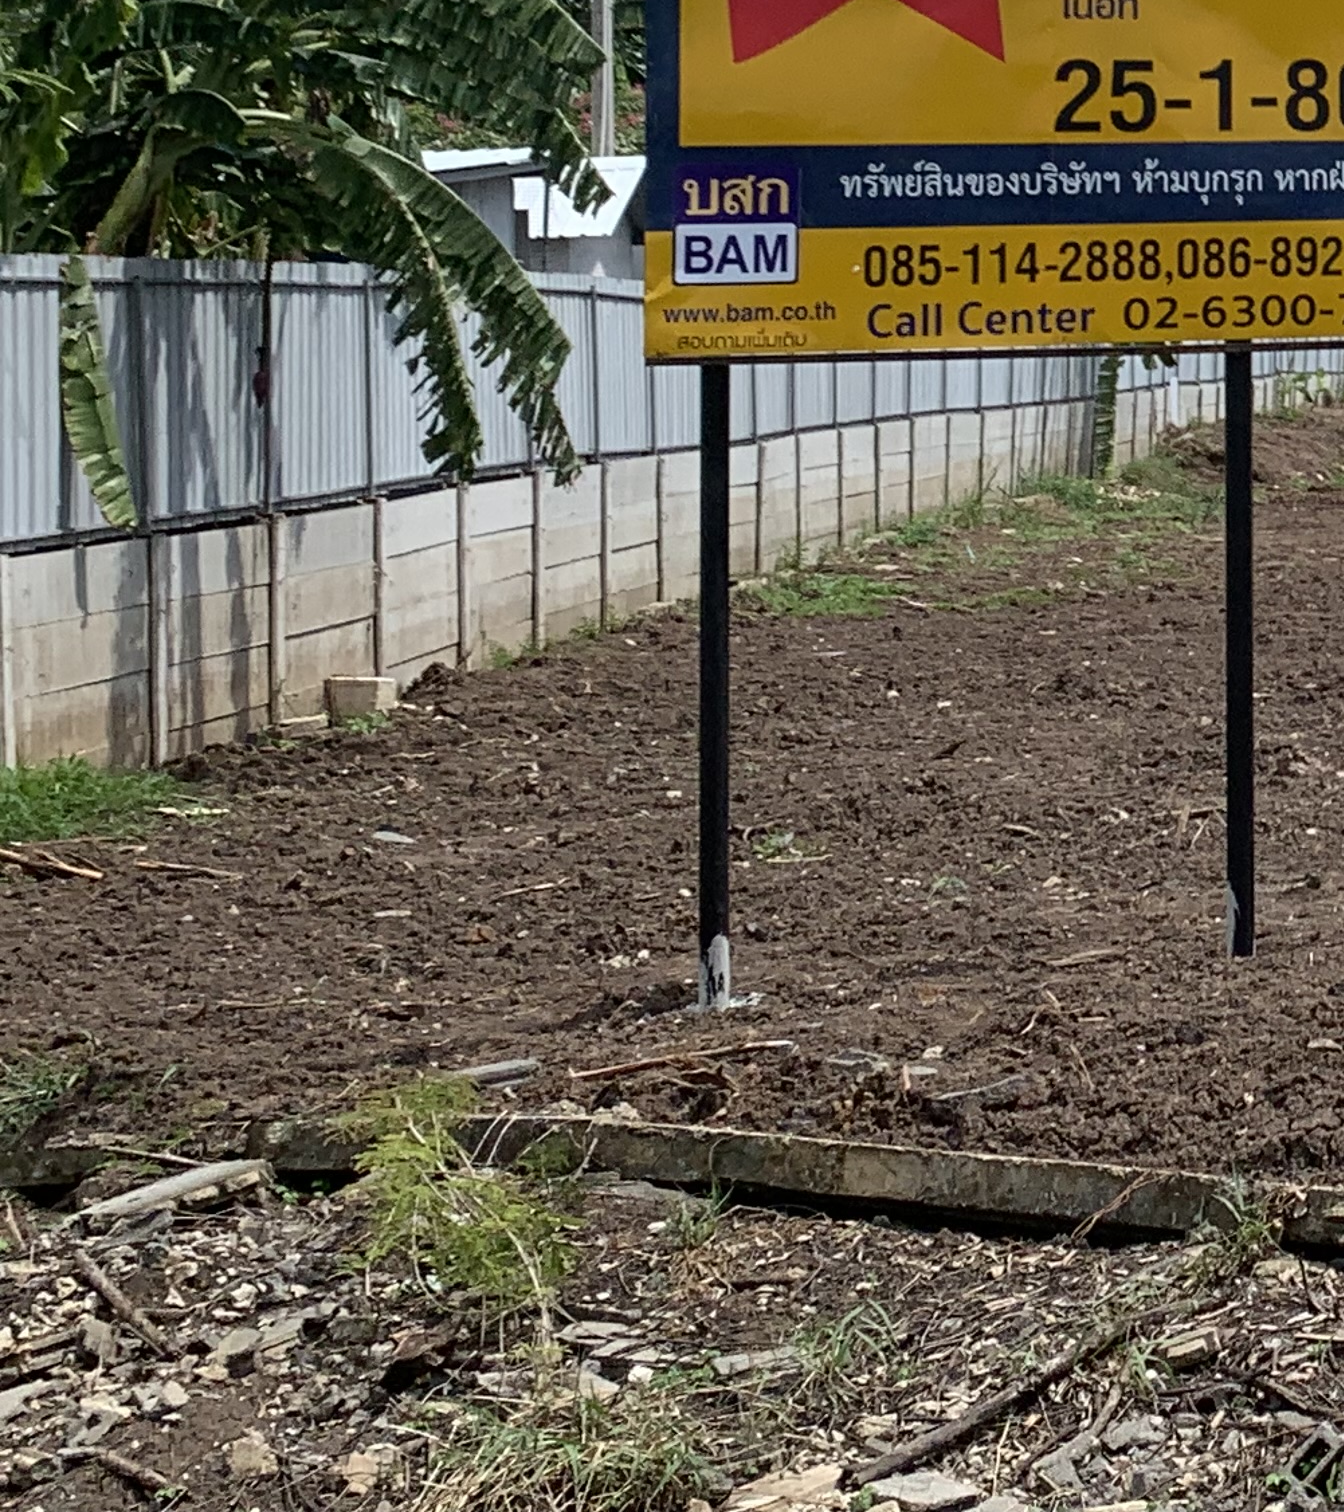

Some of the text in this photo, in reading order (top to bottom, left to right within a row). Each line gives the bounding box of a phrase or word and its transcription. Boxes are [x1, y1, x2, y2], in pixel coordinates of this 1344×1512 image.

[683, 174, 790, 216] บสก
[840, 160, 1121, 198] ทรัพย์สินของบริษัทฯ
[1131, 158, 1263, 205] ห้ามบุกรุก
[683, 234, 789, 274] BAM
[662, 301, 837, 323] www.bam.co.th
[867, 303, 943, 338] Call
[958, 301, 1095, 335] Center
